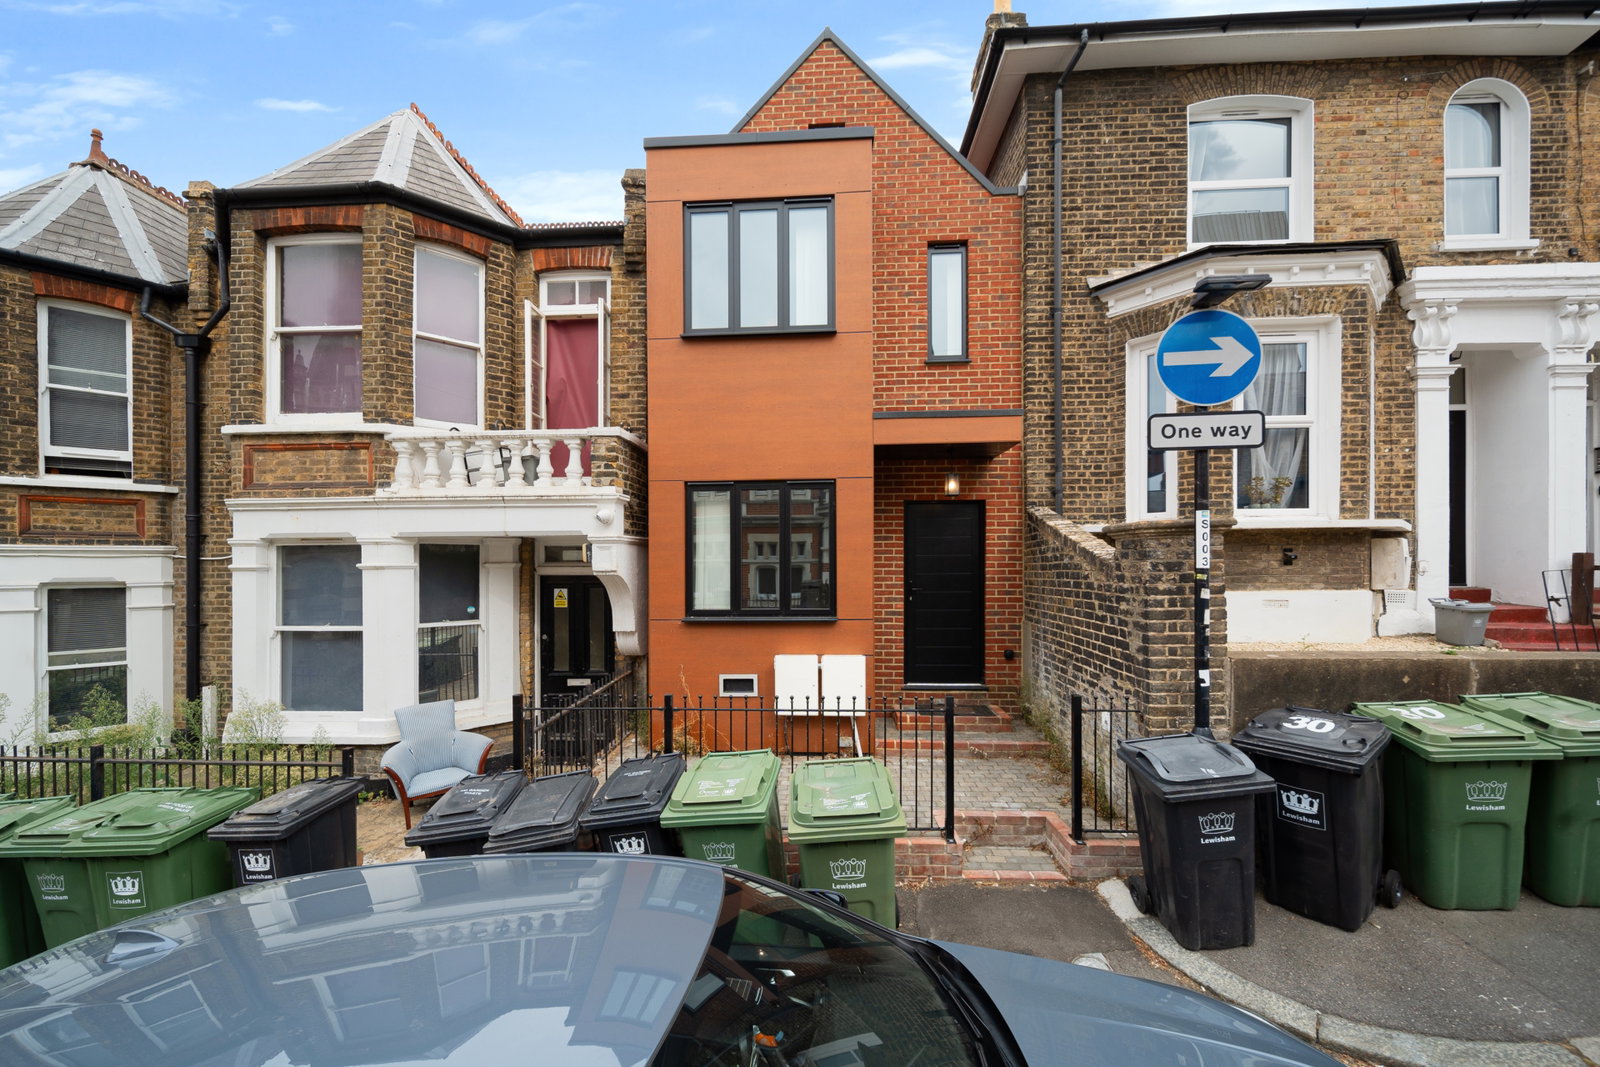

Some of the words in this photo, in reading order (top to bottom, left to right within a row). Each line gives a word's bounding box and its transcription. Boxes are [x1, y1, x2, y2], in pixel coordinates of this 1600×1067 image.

[1161, 424, 1202, 439] One
[1210, 425, 1252, 439] way
[1201, 519, 1209, 566] S003
[1387, 706, 1446, 720] 30
[1282, 716, 1336, 733] 30
[1282, 810, 1320, 825] Lewisham
[1201, 835, 1235, 844] Lewisham
[832, 882, 867, 890] Lewisham
